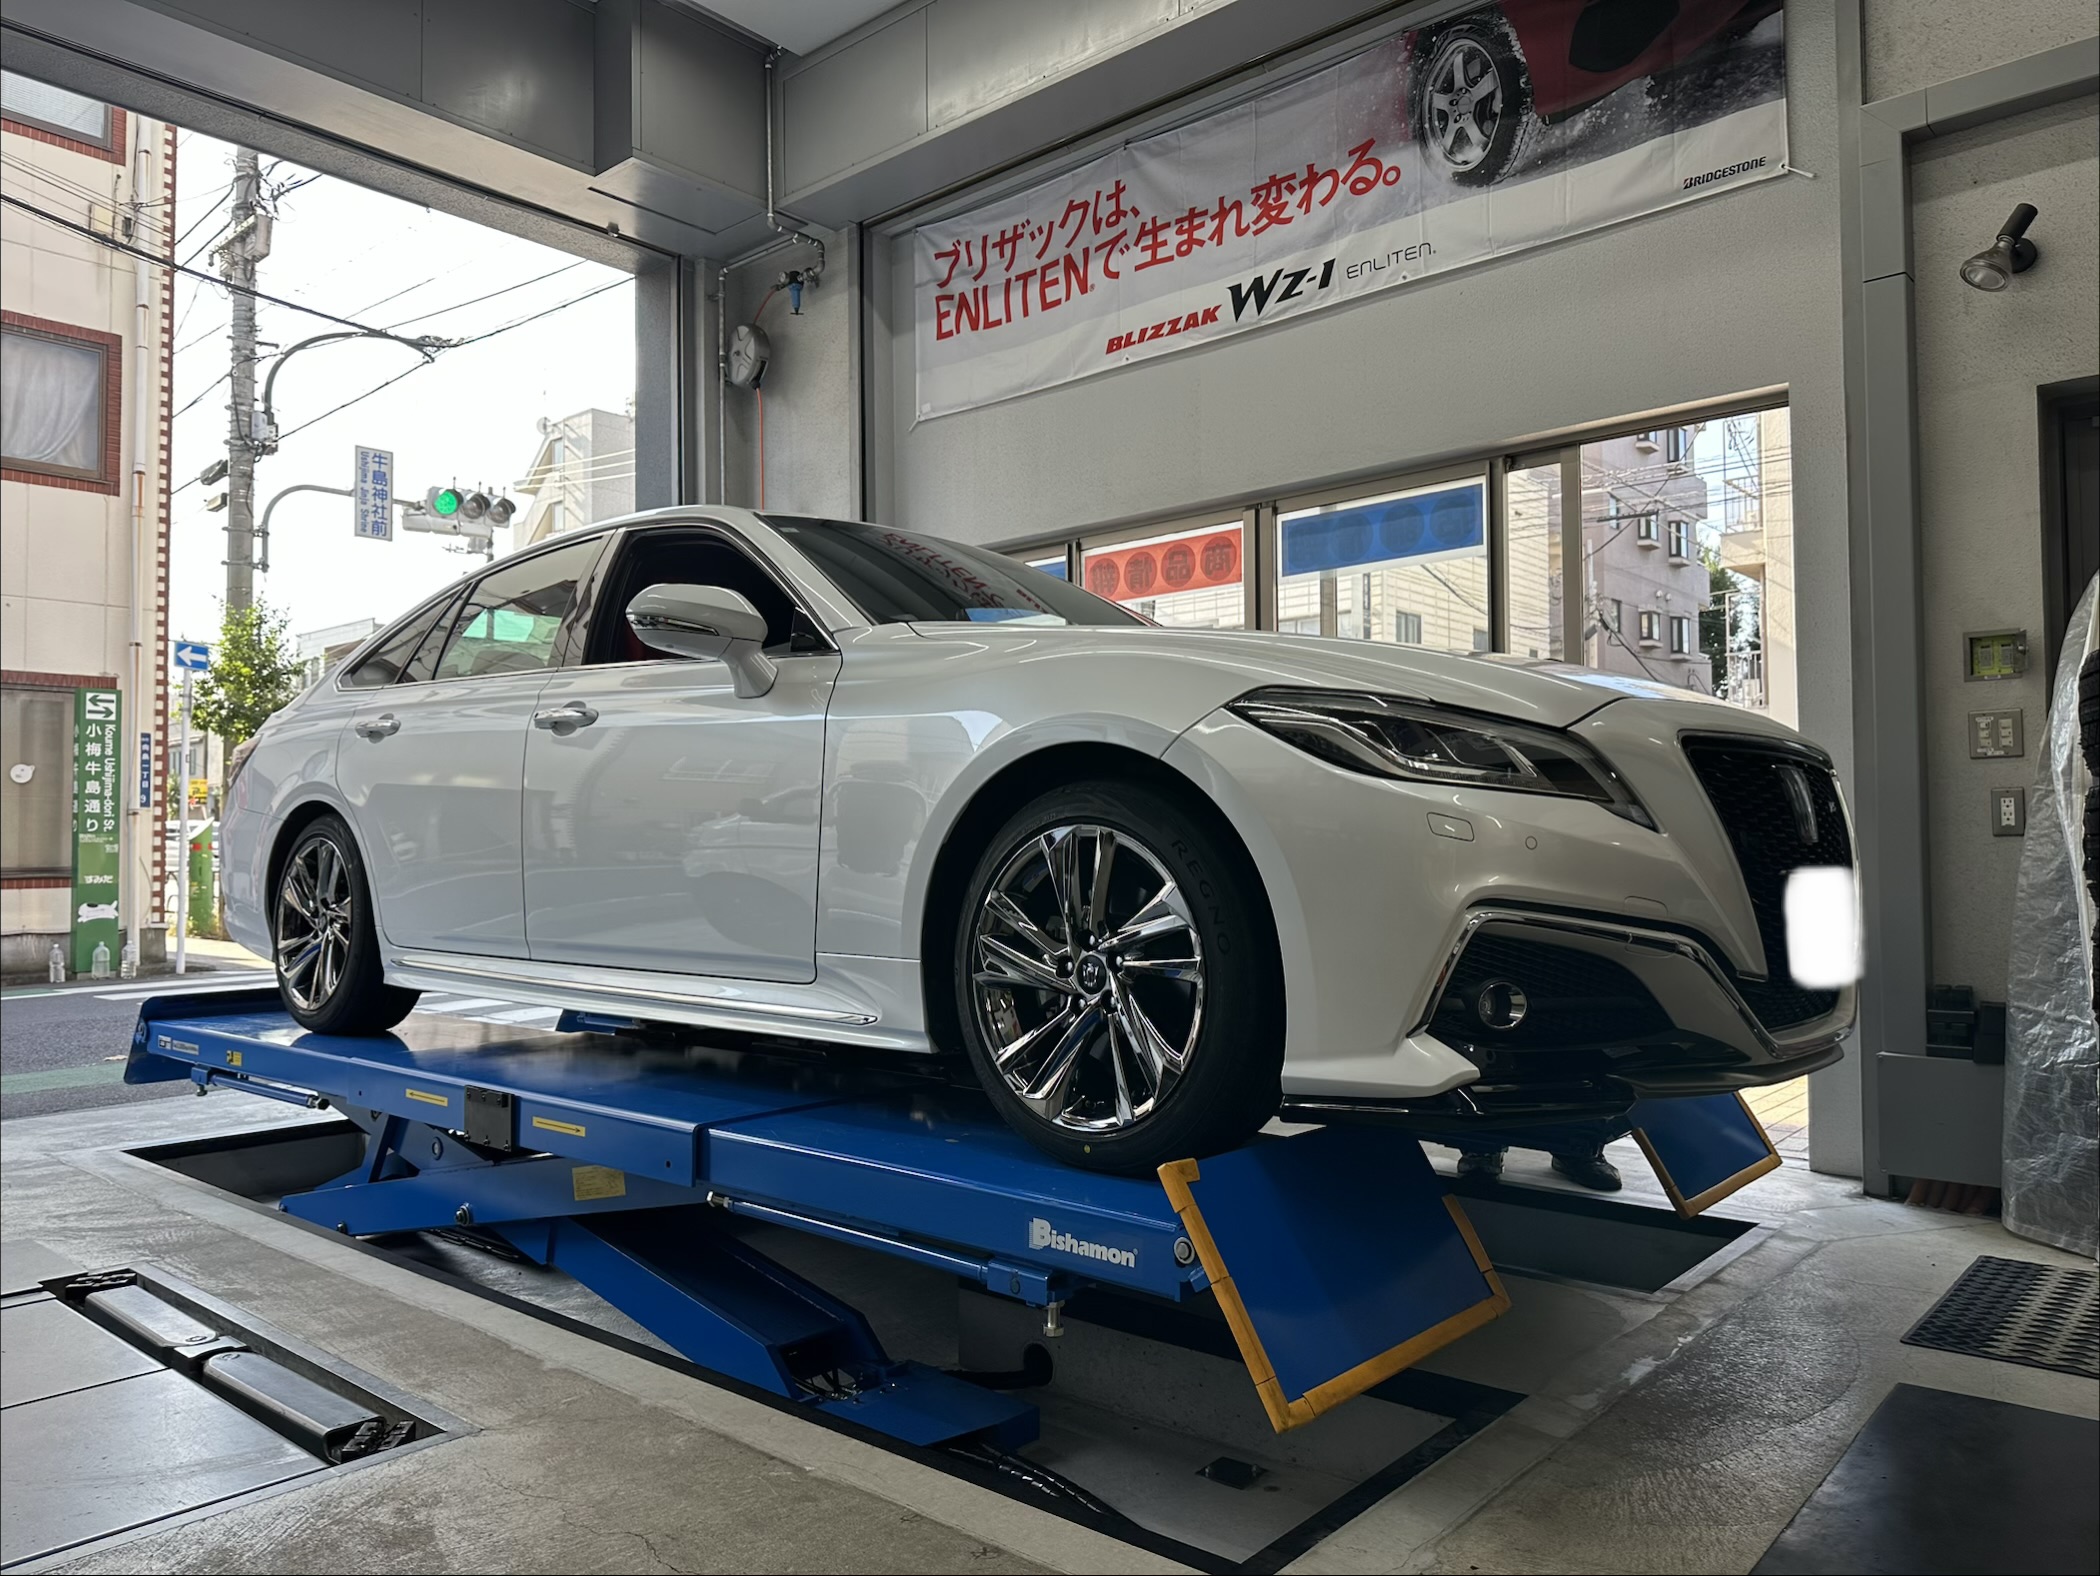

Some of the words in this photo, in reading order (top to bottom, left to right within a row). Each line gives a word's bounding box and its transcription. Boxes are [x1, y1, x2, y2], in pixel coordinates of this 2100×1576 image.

[1683, 156, 1766, 190] BRIDGESTONE
[934, 179, 1141, 288] ブリザックは、
[1105, 304, 1223, 354] BLIZZAK
[360, 508, 369, 533] Shrine
[372, 452, 388, 537] 牛島神社前
[103, 724, 116, 756] Koume
[84, 723, 102, 832] 小梅牛島通り
[101, 758, 115, 817] Ushijima-dori
[1171, 840, 1230, 955] REGNO
[1029, 1217, 1136, 1268] Bishamon
